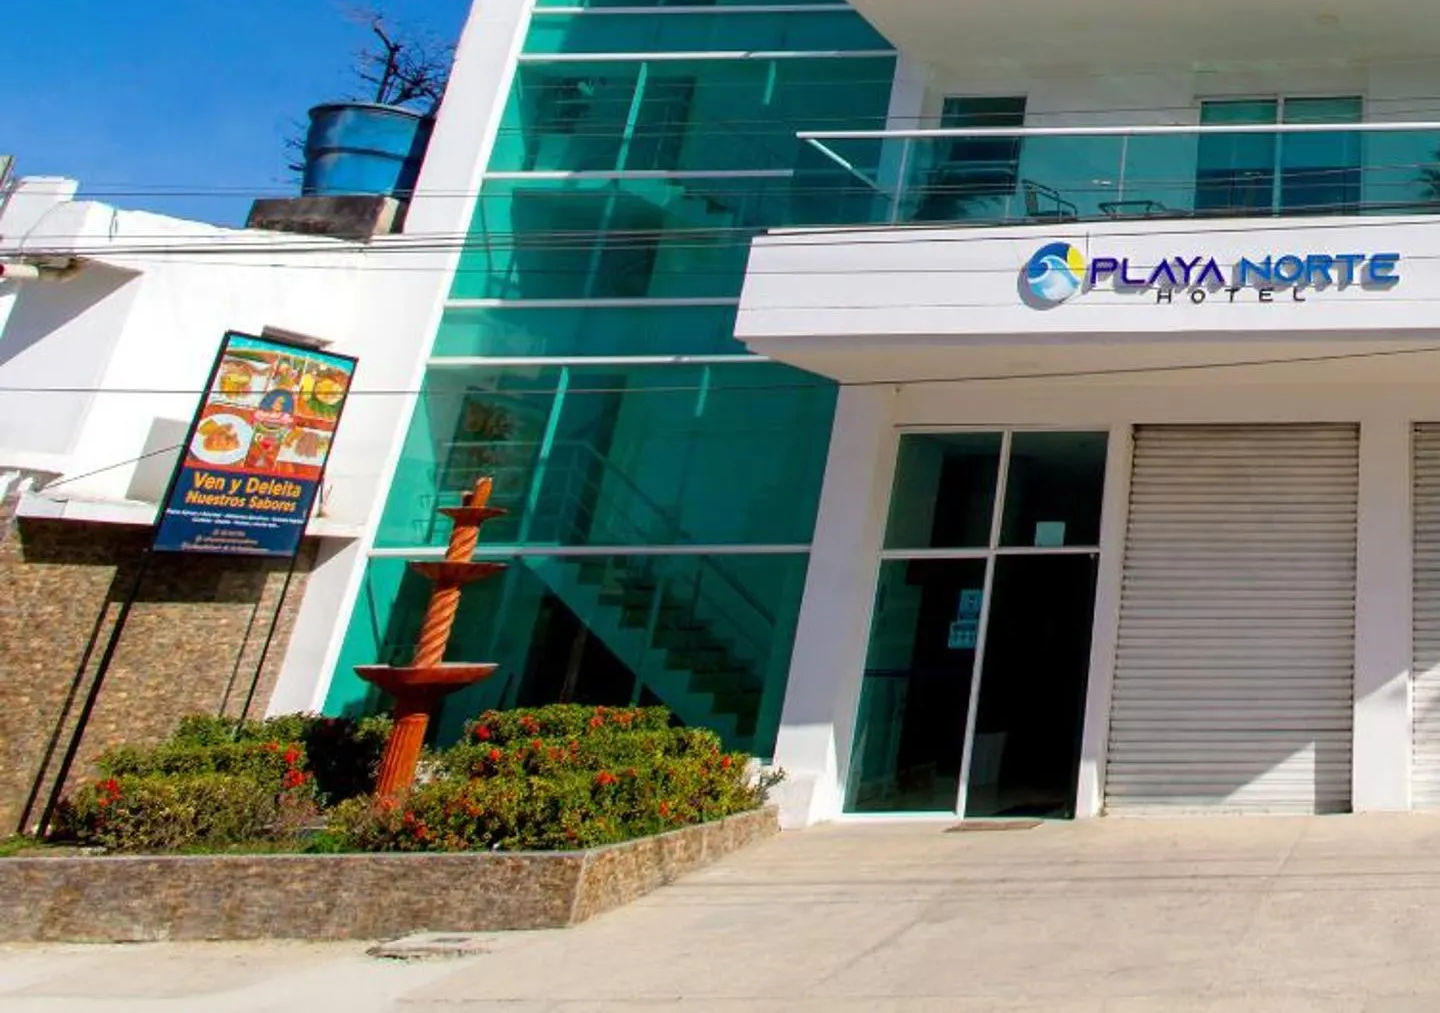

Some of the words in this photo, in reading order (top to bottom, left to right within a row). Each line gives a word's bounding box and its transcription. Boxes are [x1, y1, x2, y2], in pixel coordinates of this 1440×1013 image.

[1088, 254, 1226, 285] PLAYA
[1240, 252, 1401, 283] NORTE
[1156, 288, 1307, 304] HOTEL
[194, 471, 225, 490] Ven
[229, 478, 242, 493] y
[246, 477, 302, 497] Deleita
[185, 491, 246, 507] Nuestros
[248, 496, 297, 512] Sabores
